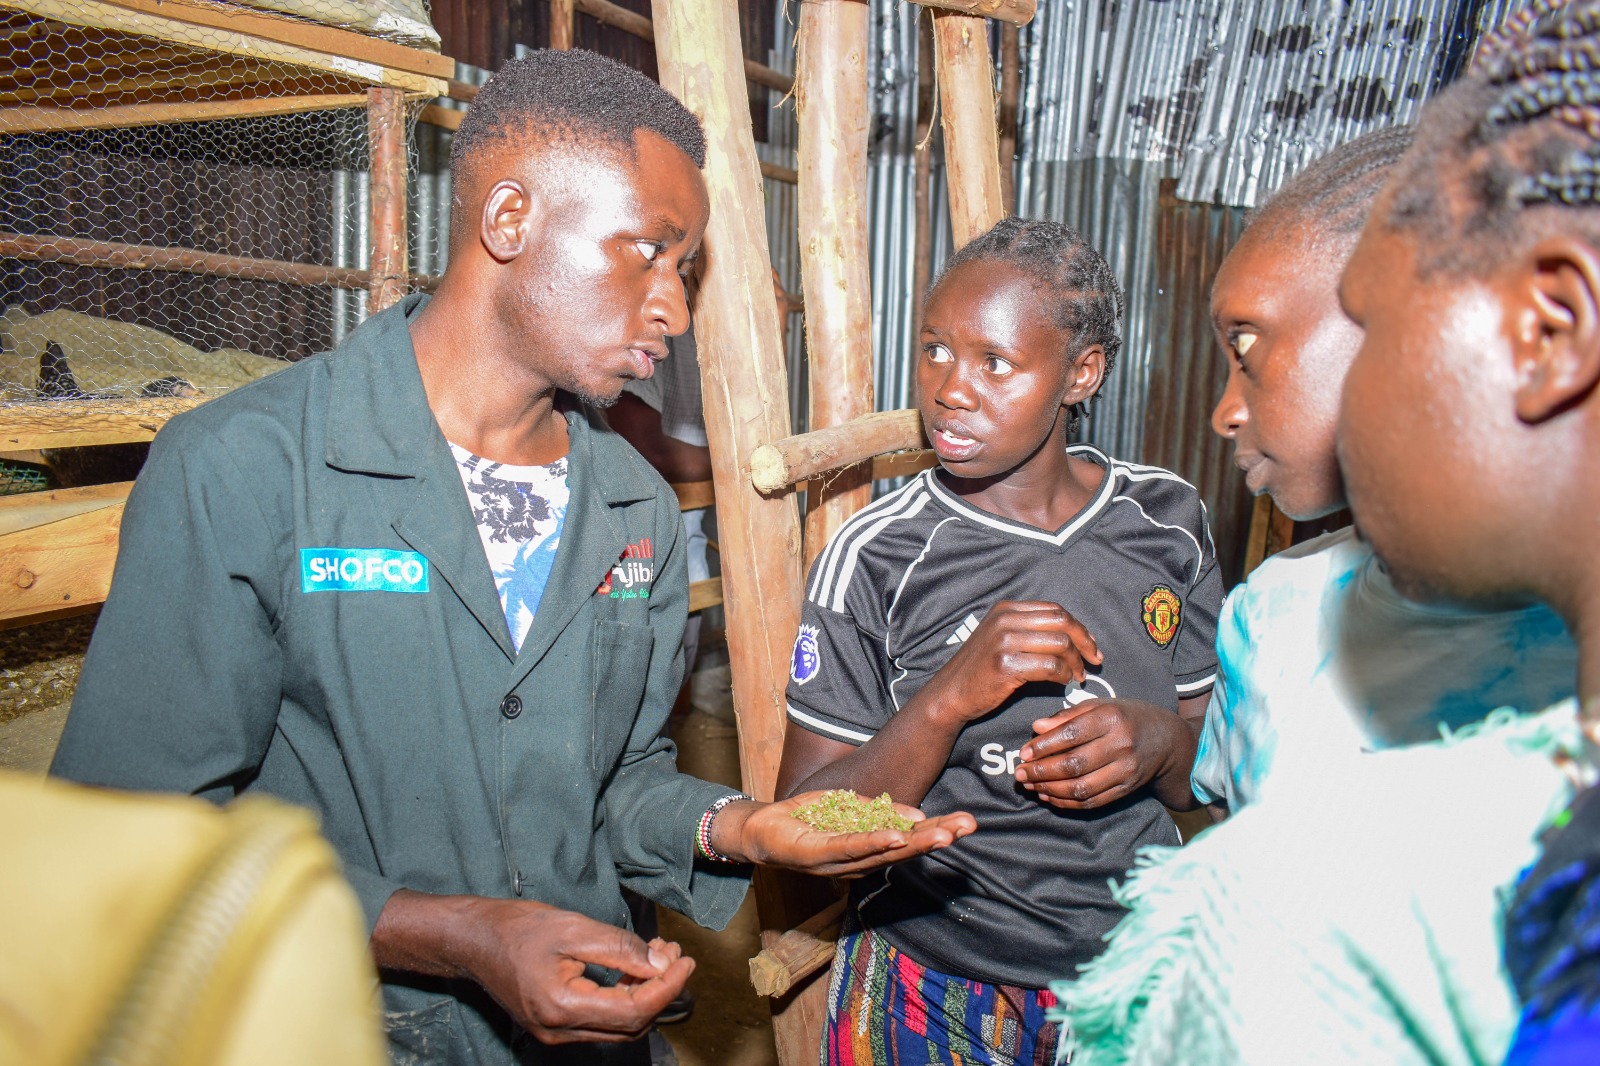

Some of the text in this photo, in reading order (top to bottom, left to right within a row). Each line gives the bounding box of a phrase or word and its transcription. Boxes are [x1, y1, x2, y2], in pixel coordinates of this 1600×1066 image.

[309, 557, 424, 585] SHOFCO
[1147, 592, 1179, 613] MANCHESTER
[1153, 629, 1172, 640] UNITED
